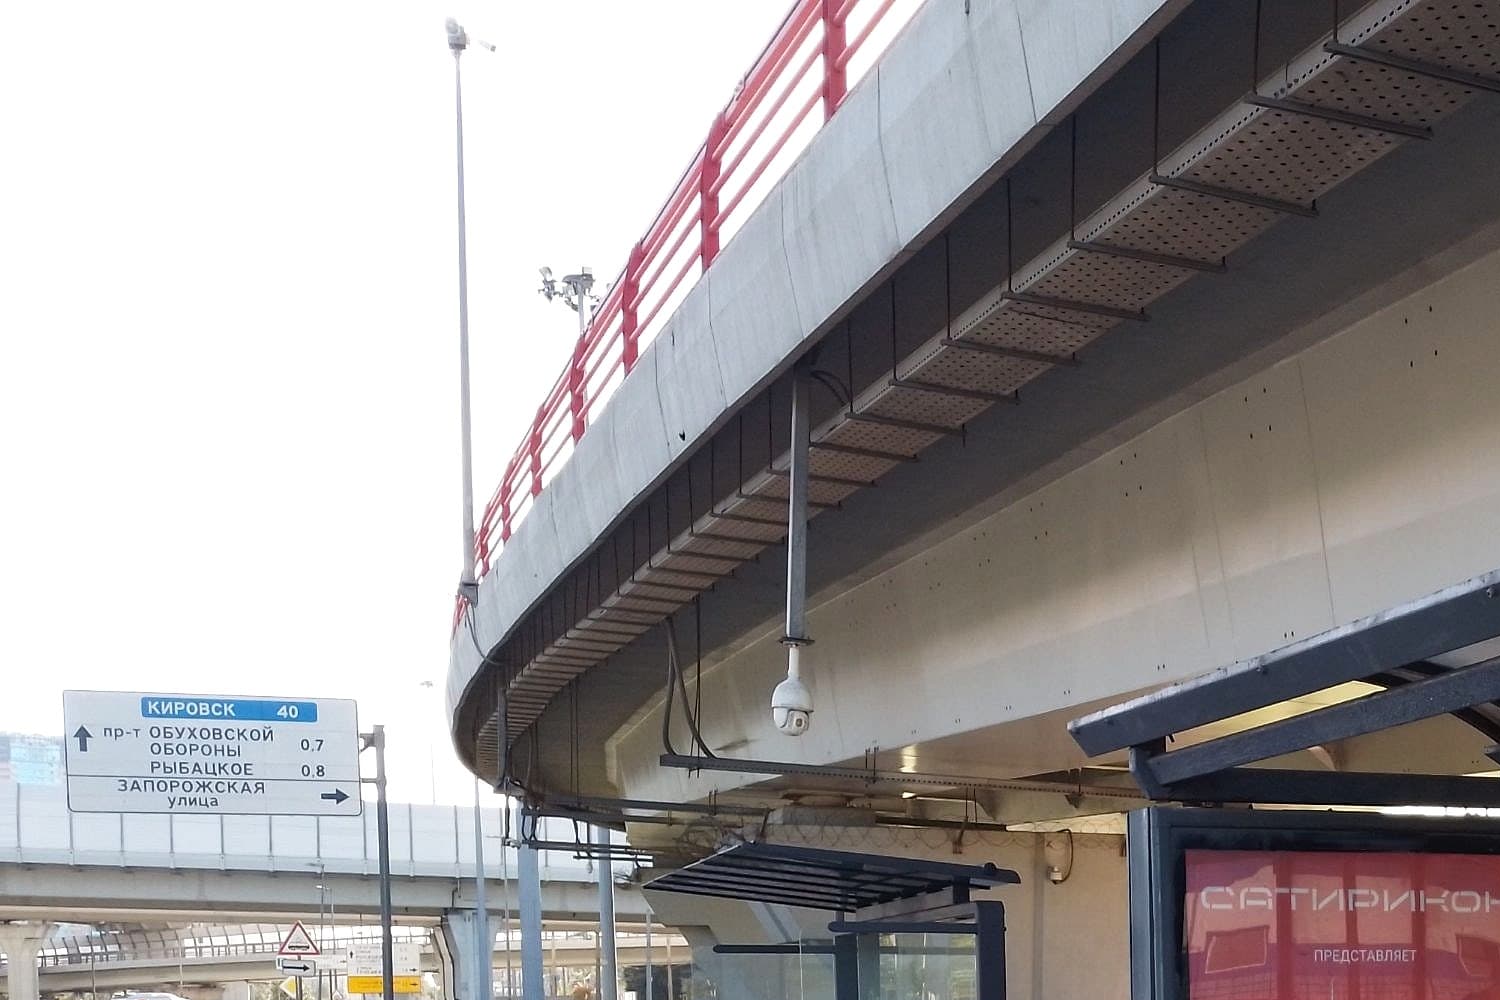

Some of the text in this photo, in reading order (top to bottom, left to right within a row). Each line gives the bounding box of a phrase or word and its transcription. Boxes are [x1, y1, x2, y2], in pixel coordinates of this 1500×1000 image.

[148, 700, 299, 719] КИРОВСК 40
[103, 725, 274, 741] пр-т ОБУХОВСКОЙ
[150, 739, 325, 757] ОБОРОНЫ 0,7
[150, 762, 326, 779] РЫБАЦКОЕ 0,8
[117, 779, 266, 794] ЗАПОРОЖСКАЯ
[167, 796, 219, 808] улица
[1313, 949, 1417, 964] ПРЕДСТАВЛЯЕТ
